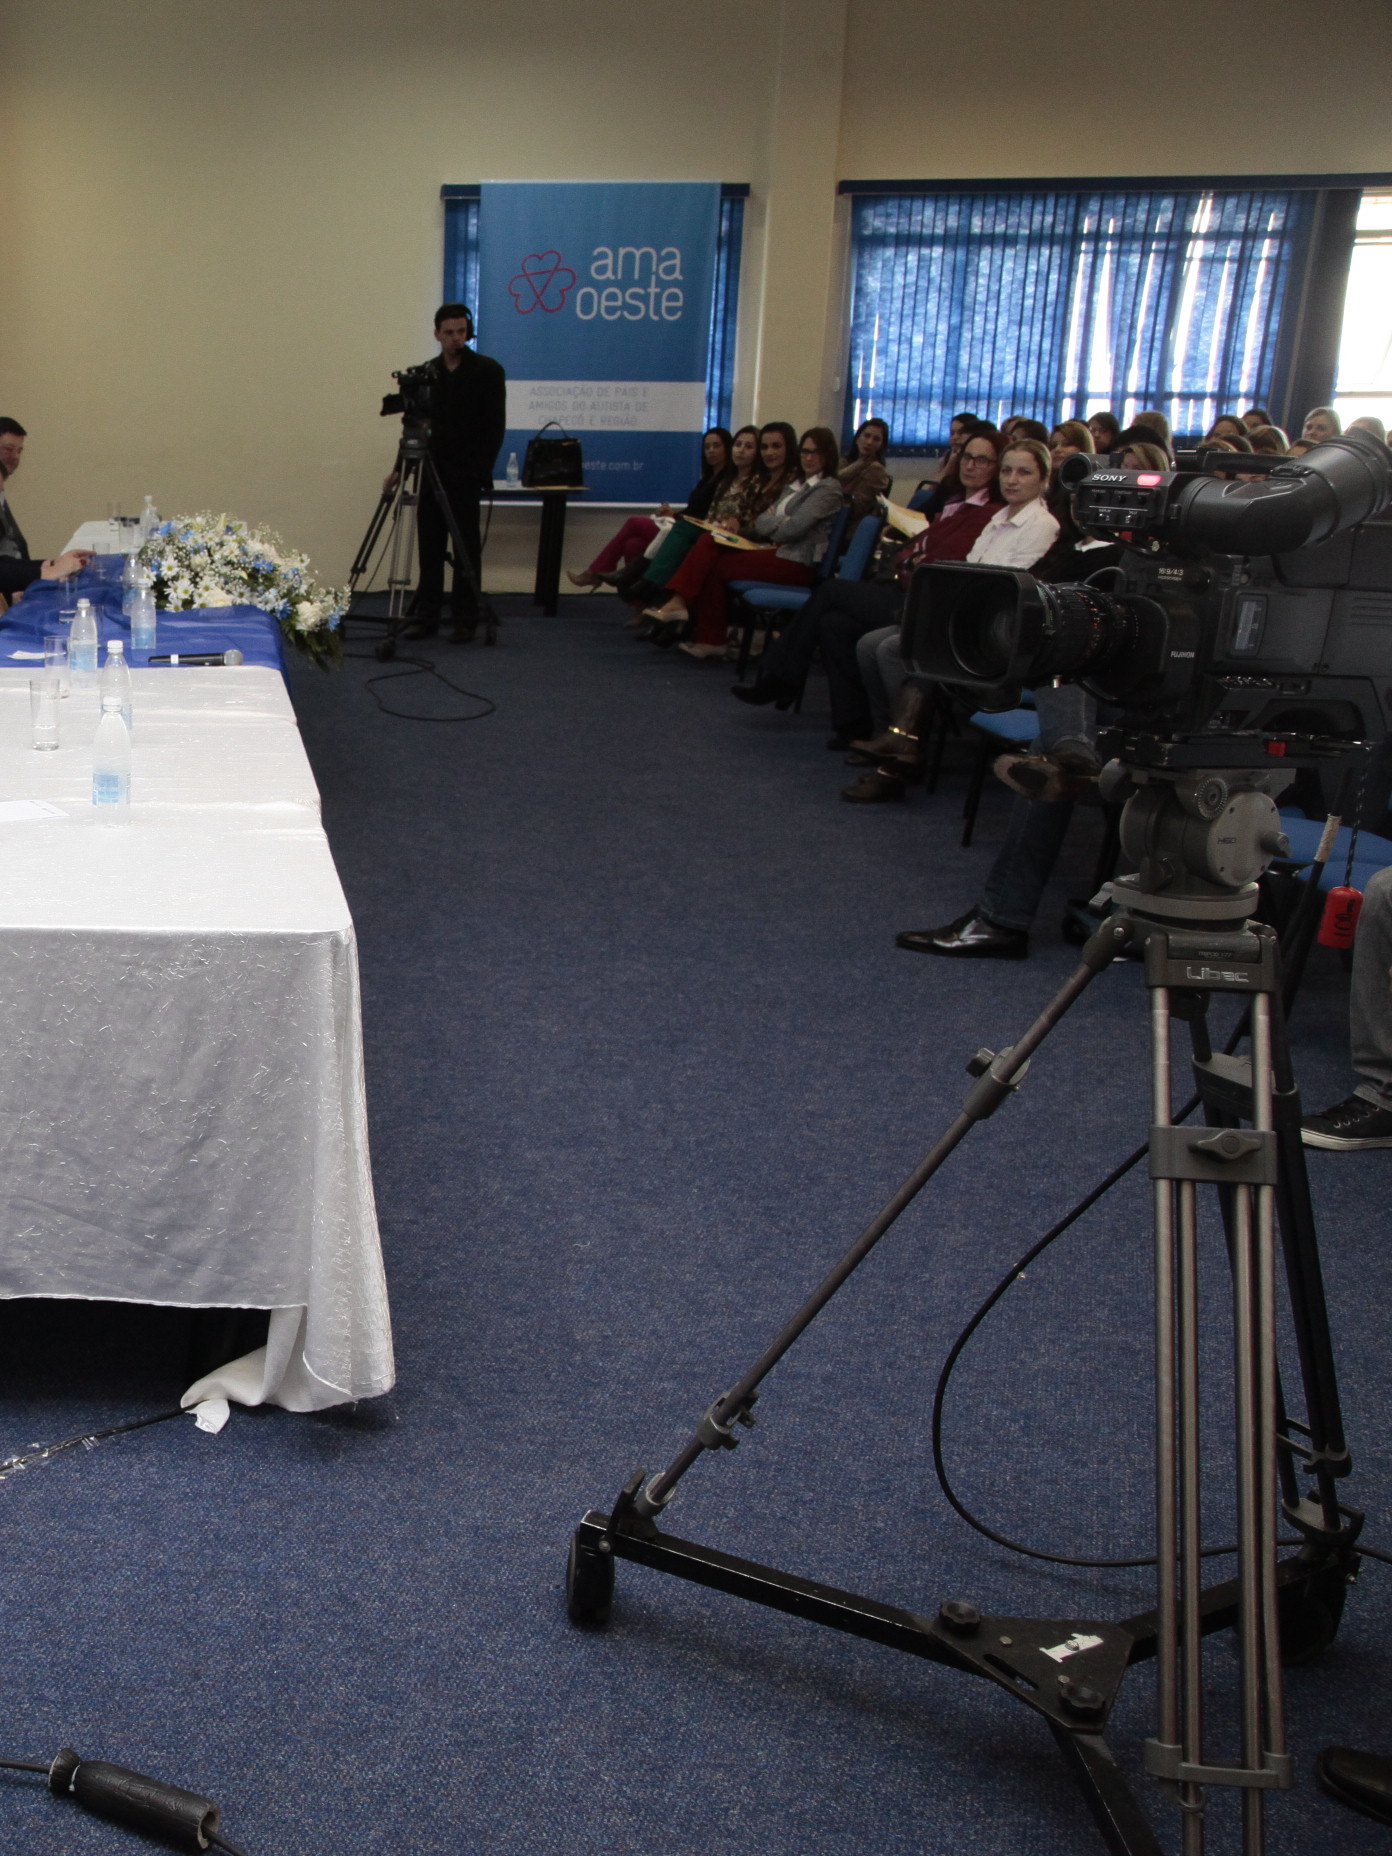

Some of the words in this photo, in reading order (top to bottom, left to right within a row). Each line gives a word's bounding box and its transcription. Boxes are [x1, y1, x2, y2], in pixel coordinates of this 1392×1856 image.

[590, 246, 683, 280] ama
[576, 274, 684, 320] oeste
[529, 385, 594, 399] ASSOCIAÇÃO
[596, 387, 611, 397] DE
[615, 387, 638, 397] PAIS
[642, 387, 649, 397] E
[528, 401, 568, 411] AMIGOS
[590, 401, 630, 411] AUTISTA
[635, 402, 649, 412] DE
[1092, 474, 1127, 482] SONY
